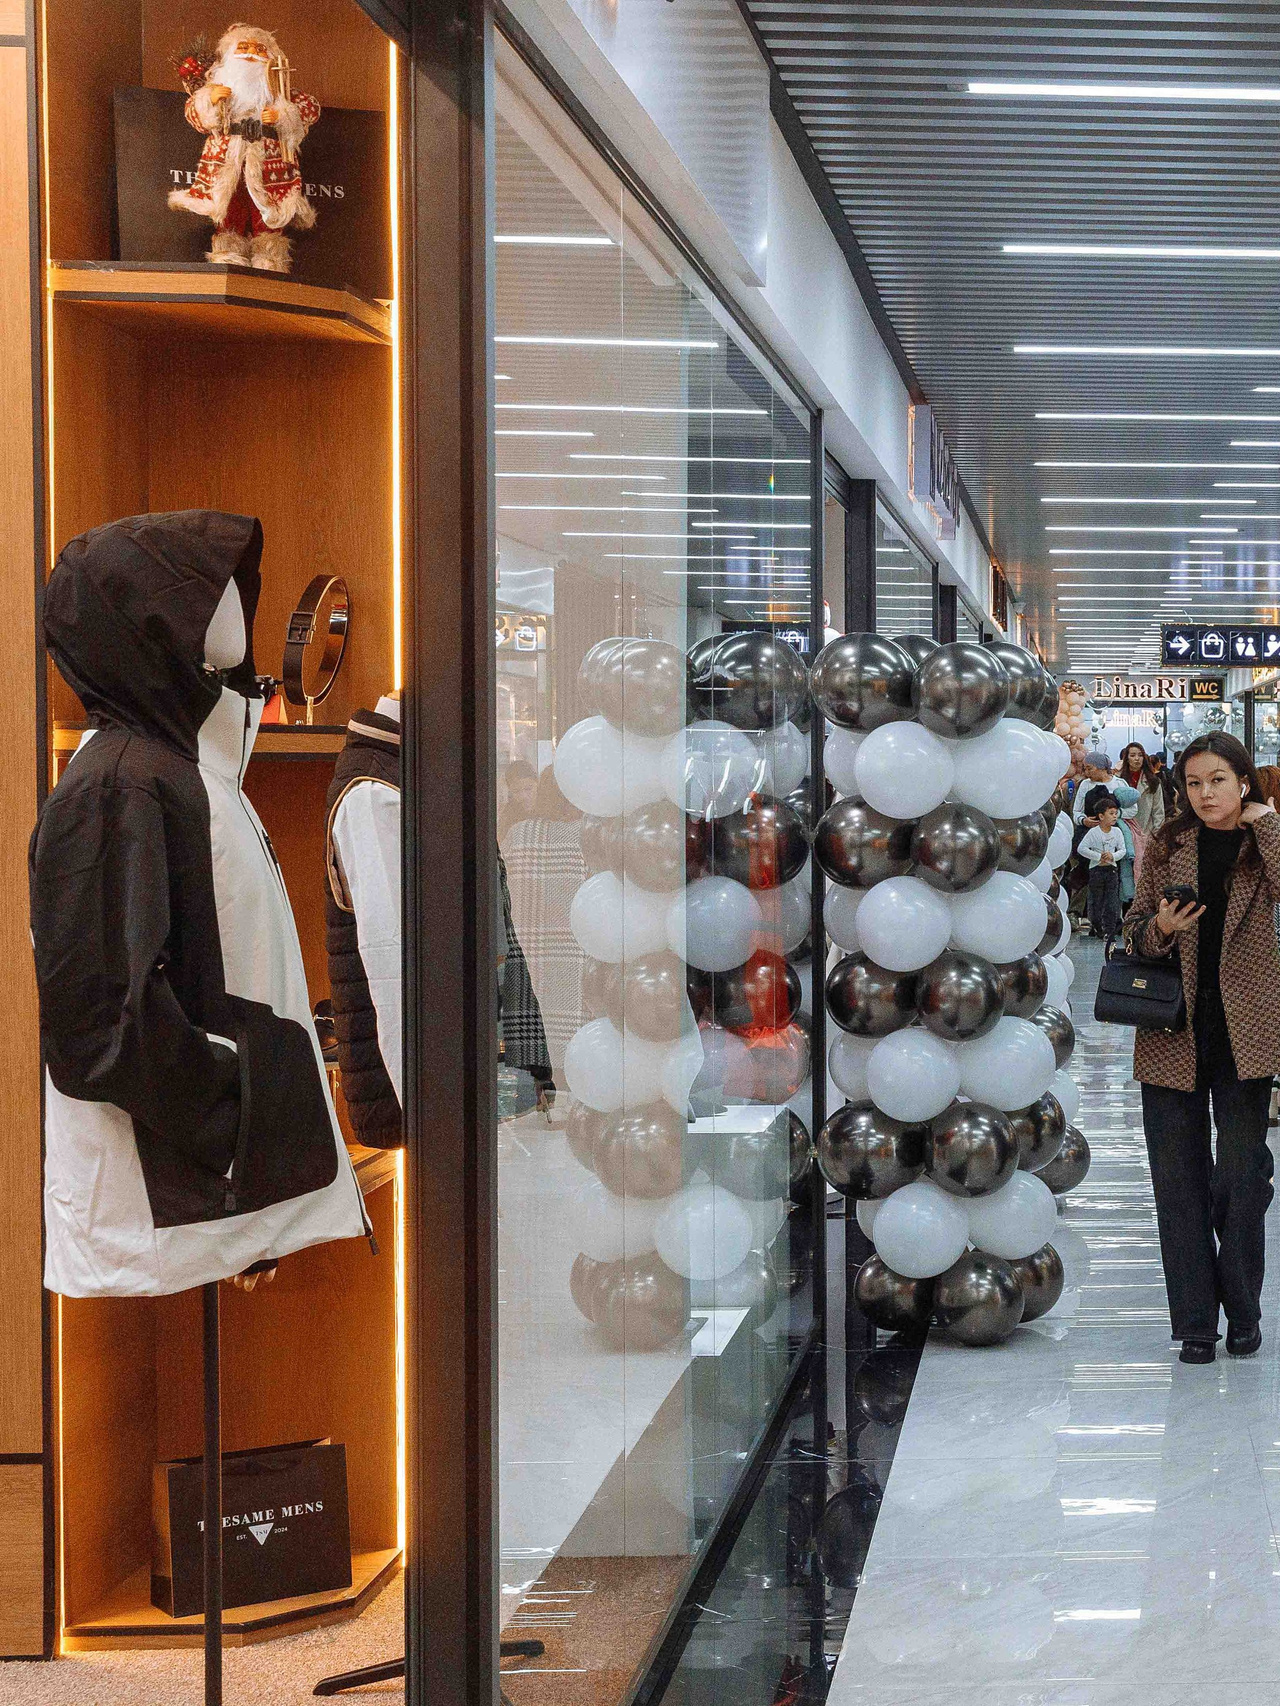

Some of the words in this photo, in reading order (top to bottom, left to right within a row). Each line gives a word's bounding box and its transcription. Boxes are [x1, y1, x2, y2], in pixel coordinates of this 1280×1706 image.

[304, 182, 346, 199] ENS
[1093, 675, 1187, 700] LinaRi
[1194, 682, 1219, 694] WC
[197, 1508, 275, 1532] TESAME
[281, 1500, 324, 1518] MENS
[274, 1526, 288, 1534] 2024
